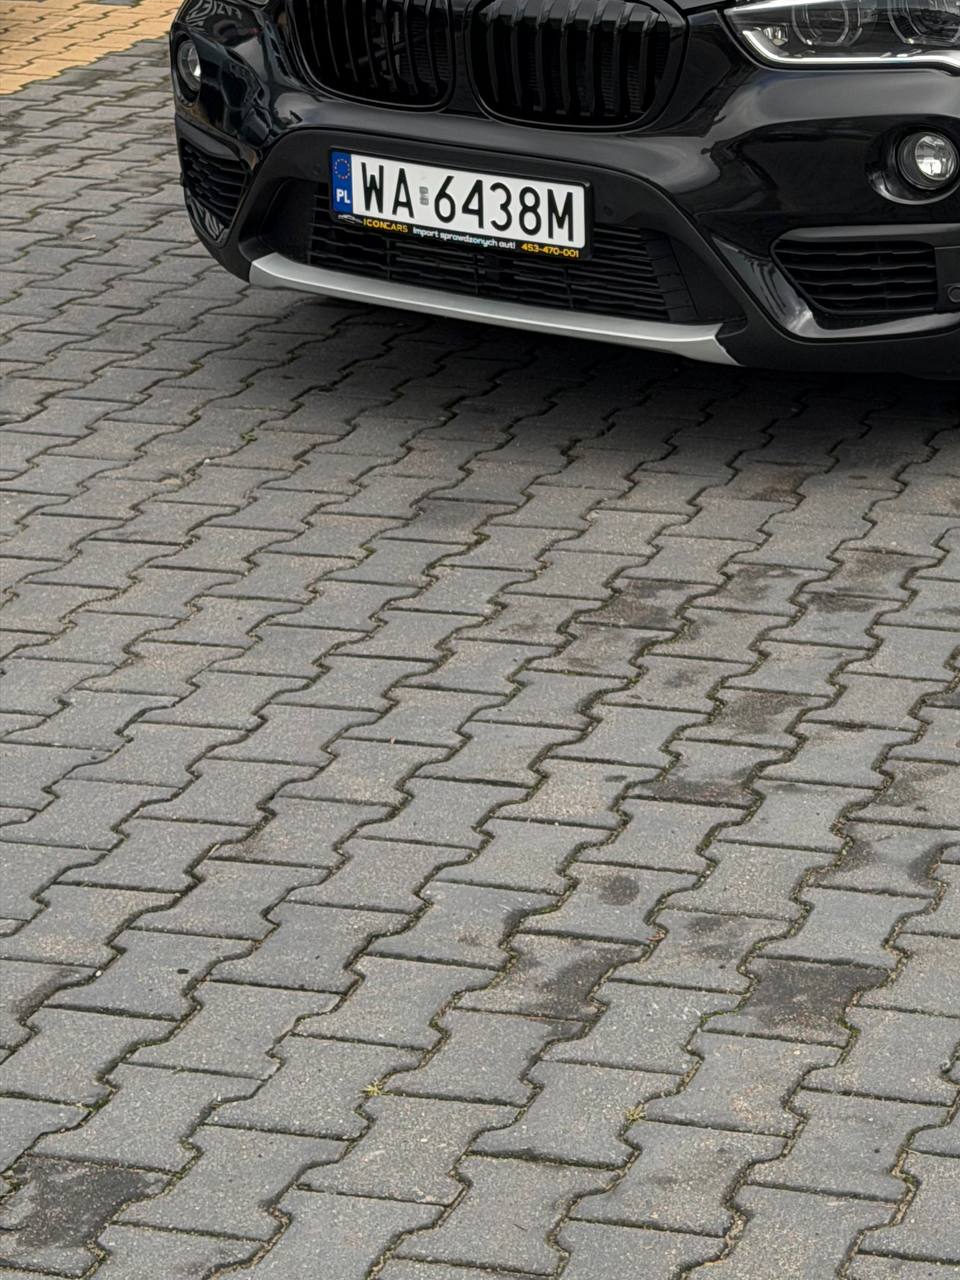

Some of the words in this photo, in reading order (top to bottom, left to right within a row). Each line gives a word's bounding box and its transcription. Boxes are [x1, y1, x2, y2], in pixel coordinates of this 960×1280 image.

[336, 188, 351, 204] PL
[360, 161, 415, 220] WA
[434, 175, 575, 242] 6438M
[363, 217, 408, 233] ICONCARS
[412, 226, 439, 239] Import
[521, 242, 580, 258] 453-470-001
